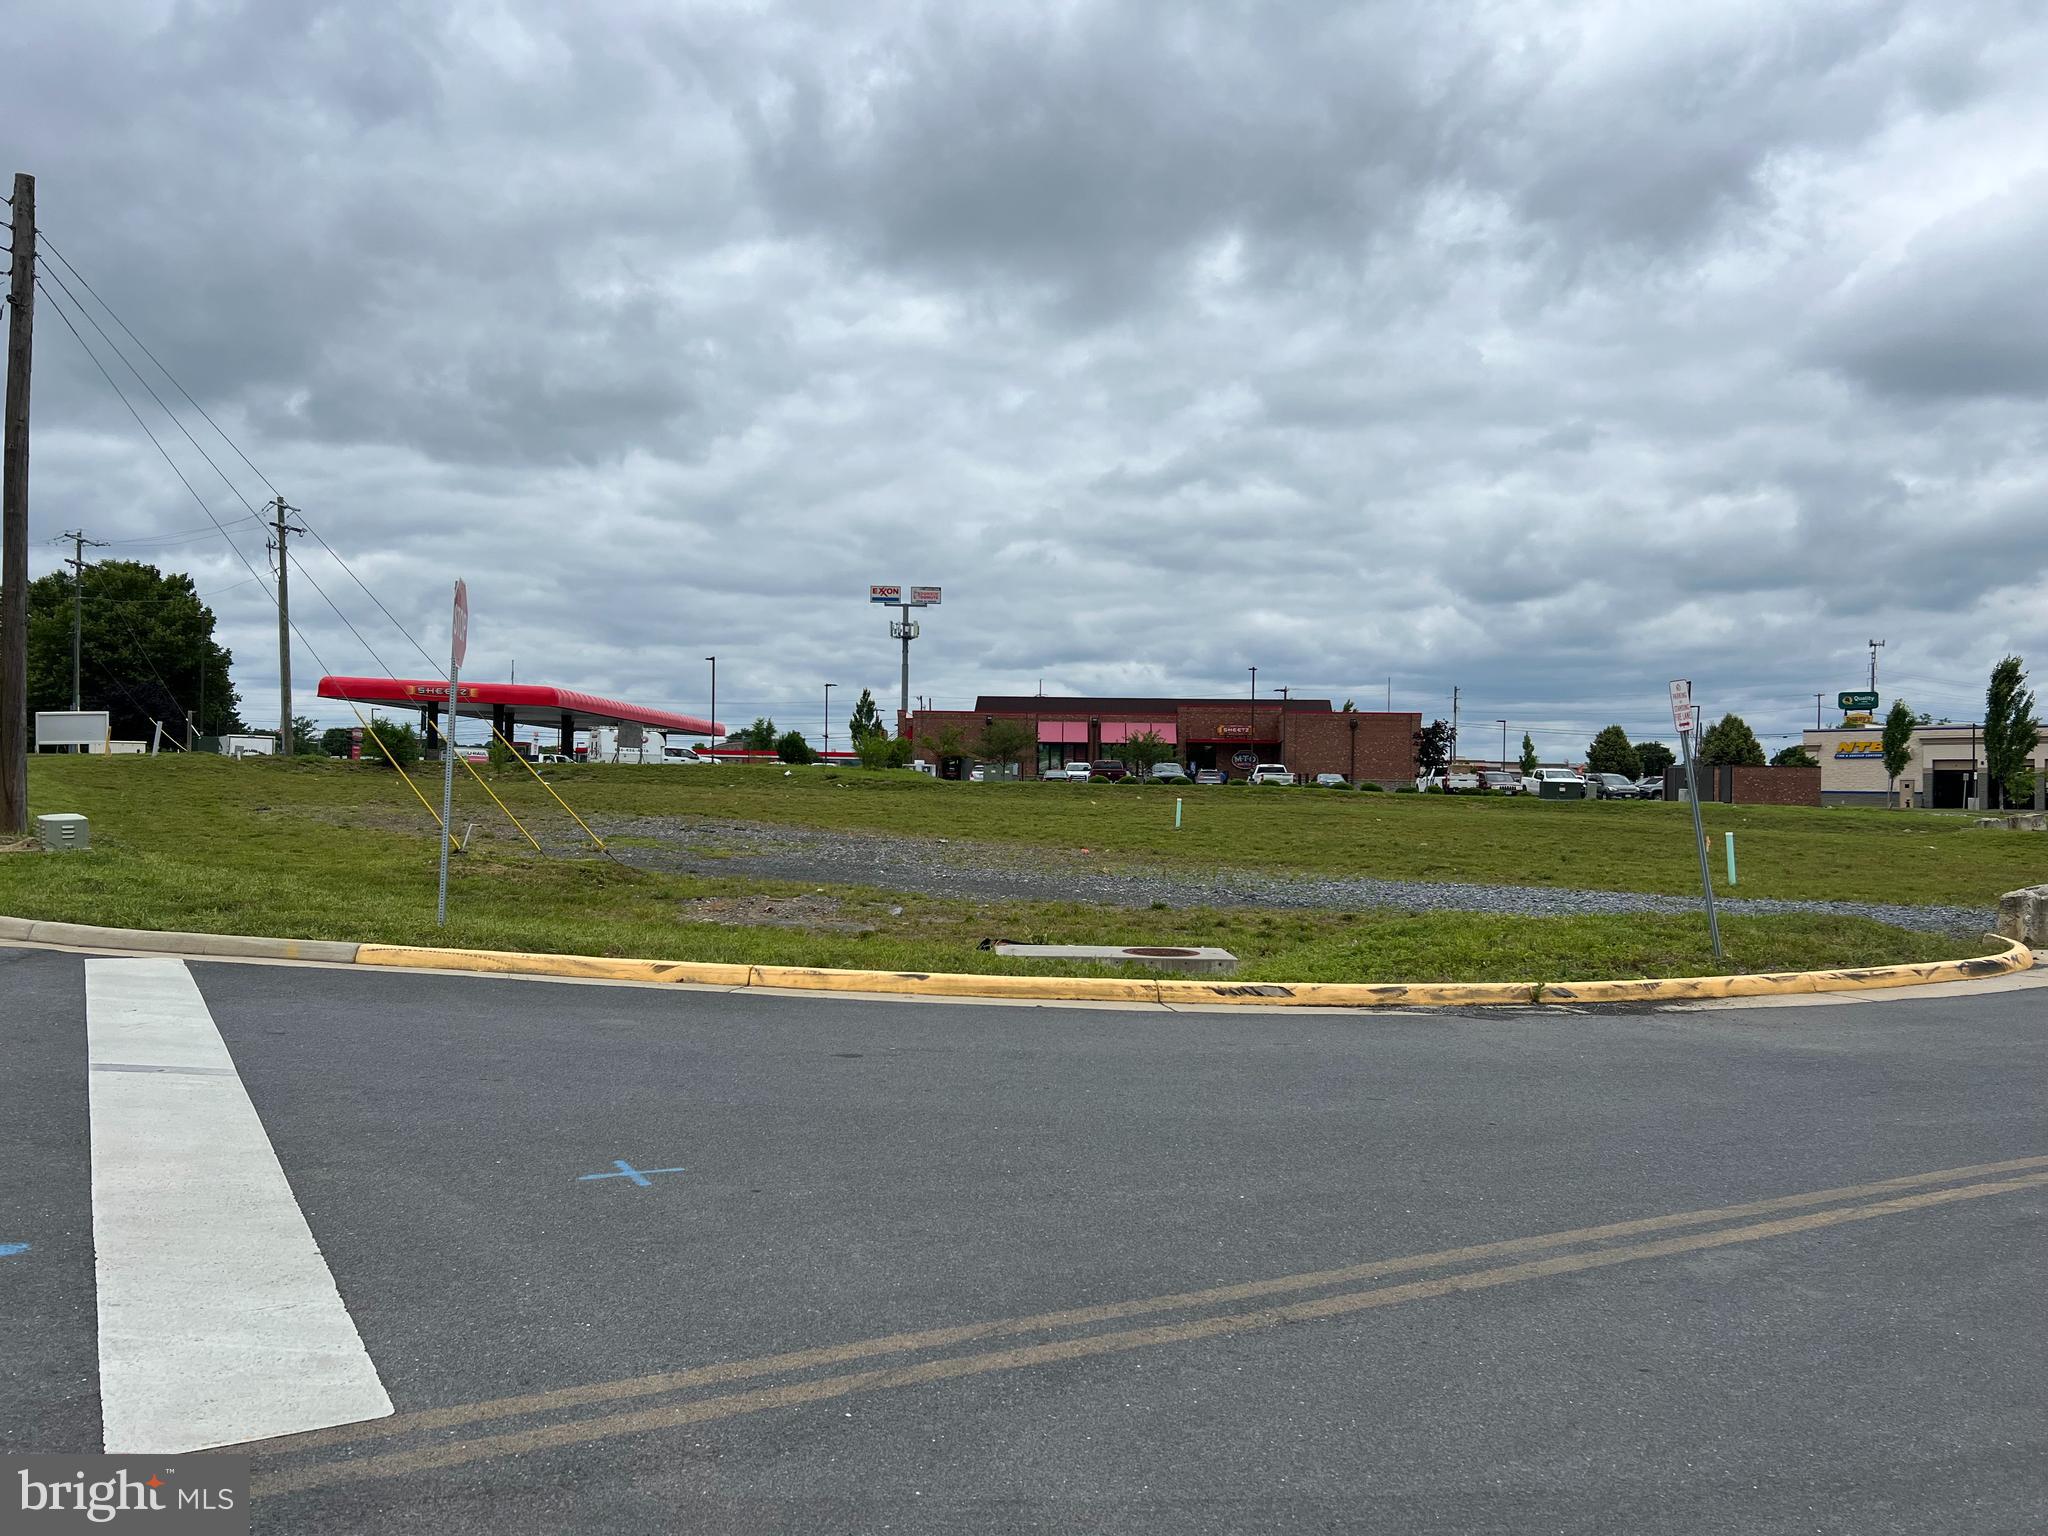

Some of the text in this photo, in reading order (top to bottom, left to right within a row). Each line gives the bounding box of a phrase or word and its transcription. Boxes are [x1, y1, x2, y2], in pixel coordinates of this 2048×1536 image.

[872, 587, 899, 598] EXXON
[417, 686, 468, 696] SHEEZ
[1836, 741, 1884, 752] NTB
